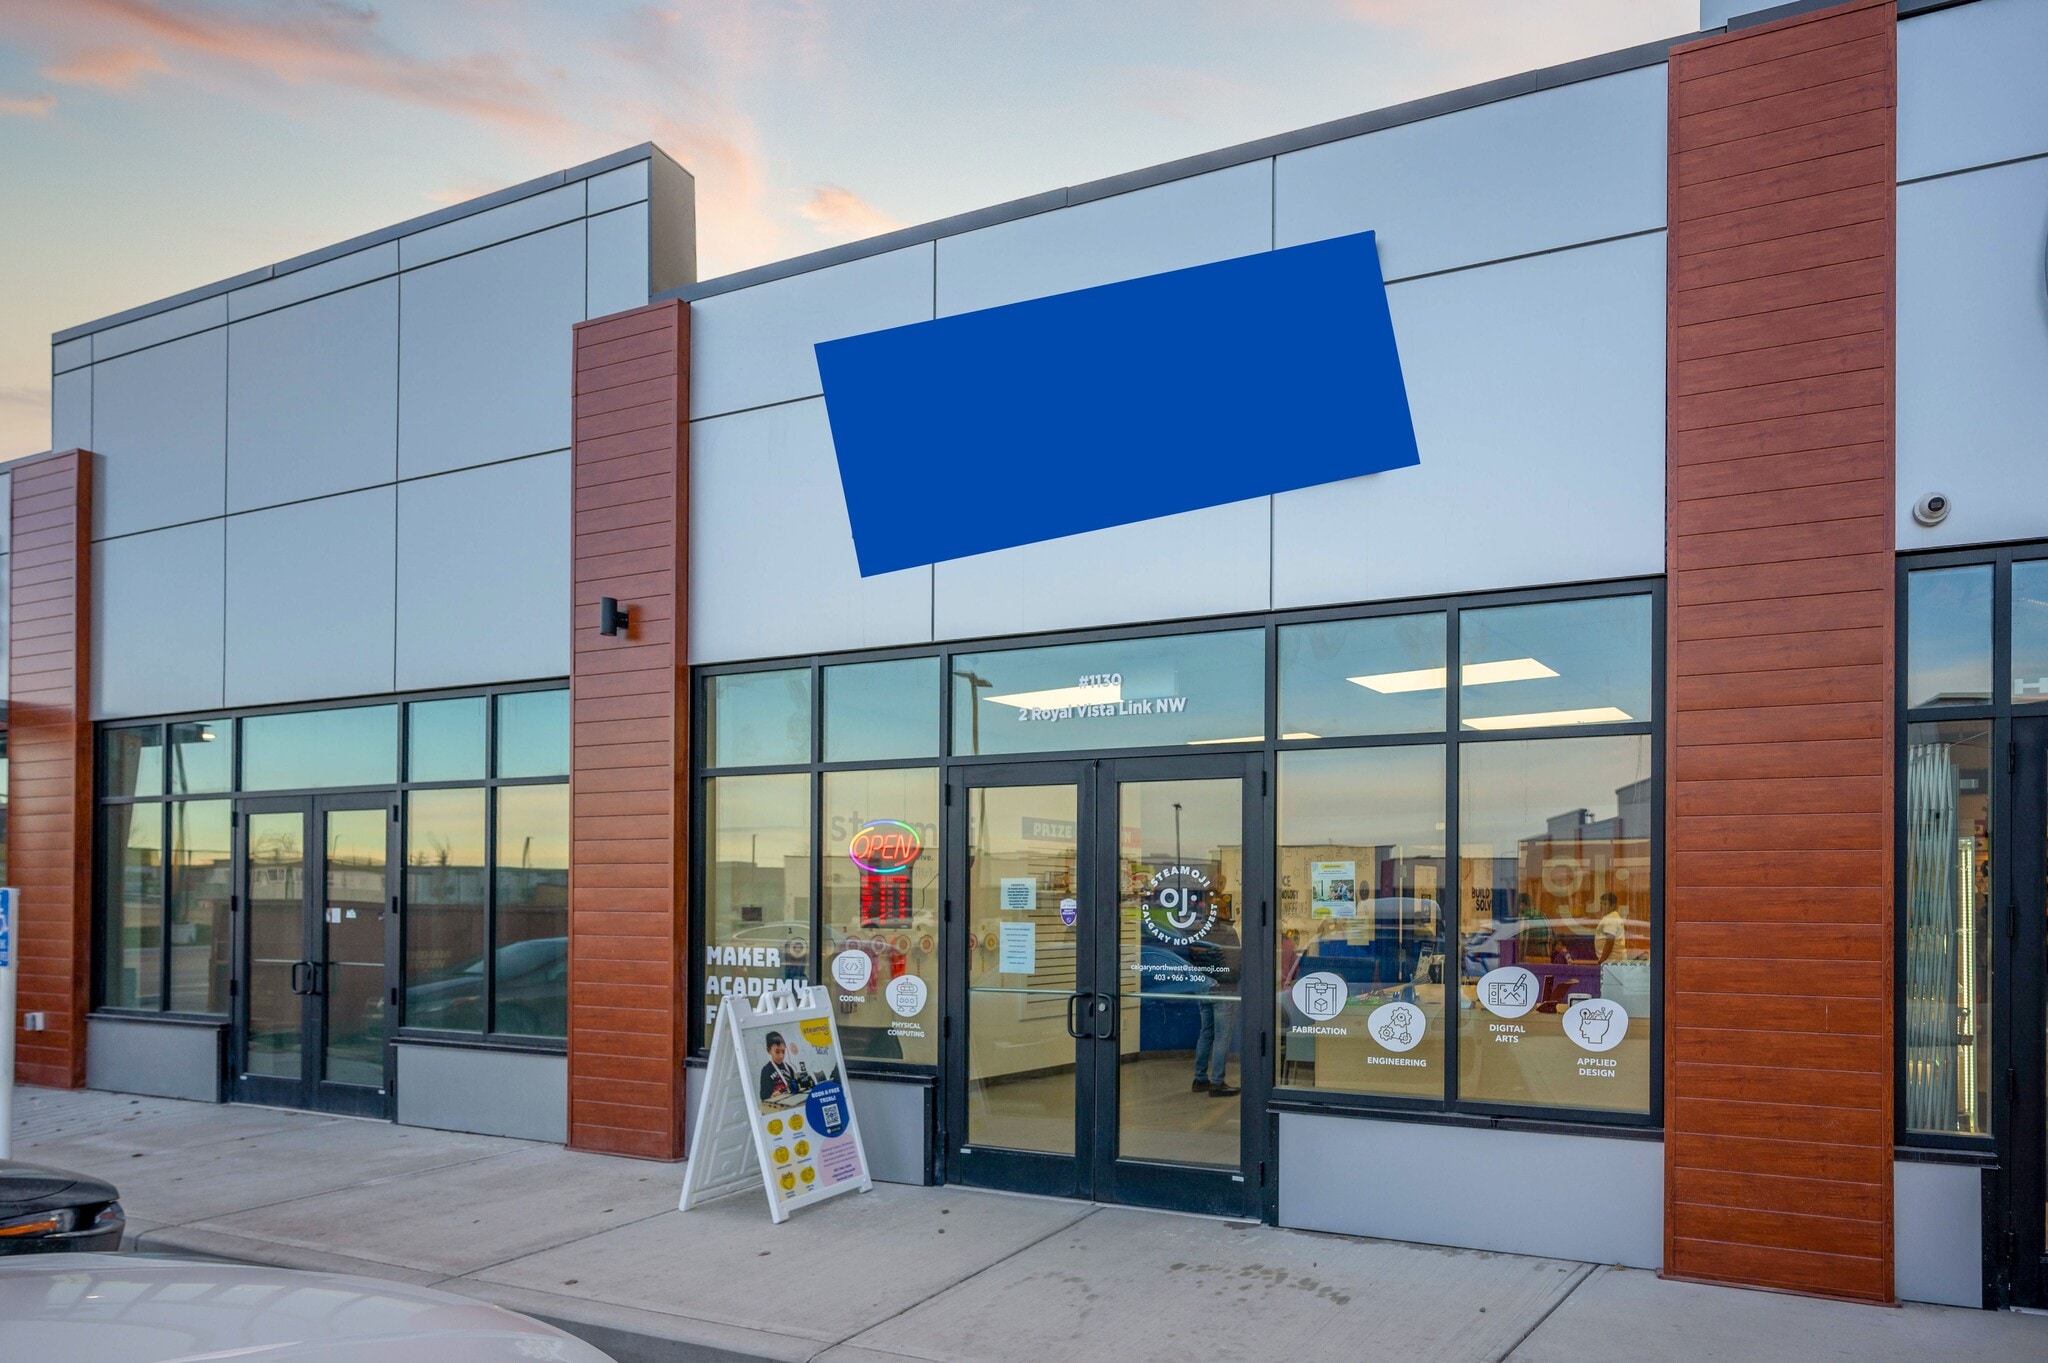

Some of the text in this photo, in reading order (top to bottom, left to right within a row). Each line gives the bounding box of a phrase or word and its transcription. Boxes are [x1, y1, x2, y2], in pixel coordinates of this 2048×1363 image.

[1079, 673, 1122, 688] #1130
[1018, 697, 1187, 722] 2 Royal Vista Link NW
[1033, 822, 1073, 839] PRIZE
[853, 834, 914, 860] OPEN
[1150, 865, 1211, 888] STEAMOJI
[1475, 899, 1492, 911] SOLV
[1142, 903, 1218, 946] CALGARY NORTHWEST
[706, 946, 781, 968] MAKER
[706, 975, 808, 999] ACADEMY
[839, 995, 865, 1003] CODING
[891, 1021, 921, 1029] PHYSICAL
[1292, 1025, 1347, 1035] FABRICATION
[1489, 1024, 1526, 1033] DIGITAL
[887, 1029, 925, 1037] COMPUTING
[1495, 1035, 1519, 1043] ARTS
[1367, 1056, 1427, 1067] ENGINEERING
[1577, 1058, 1617, 1067] APPLIED
[1579, 1068, 1615, 1077] DESIGN
